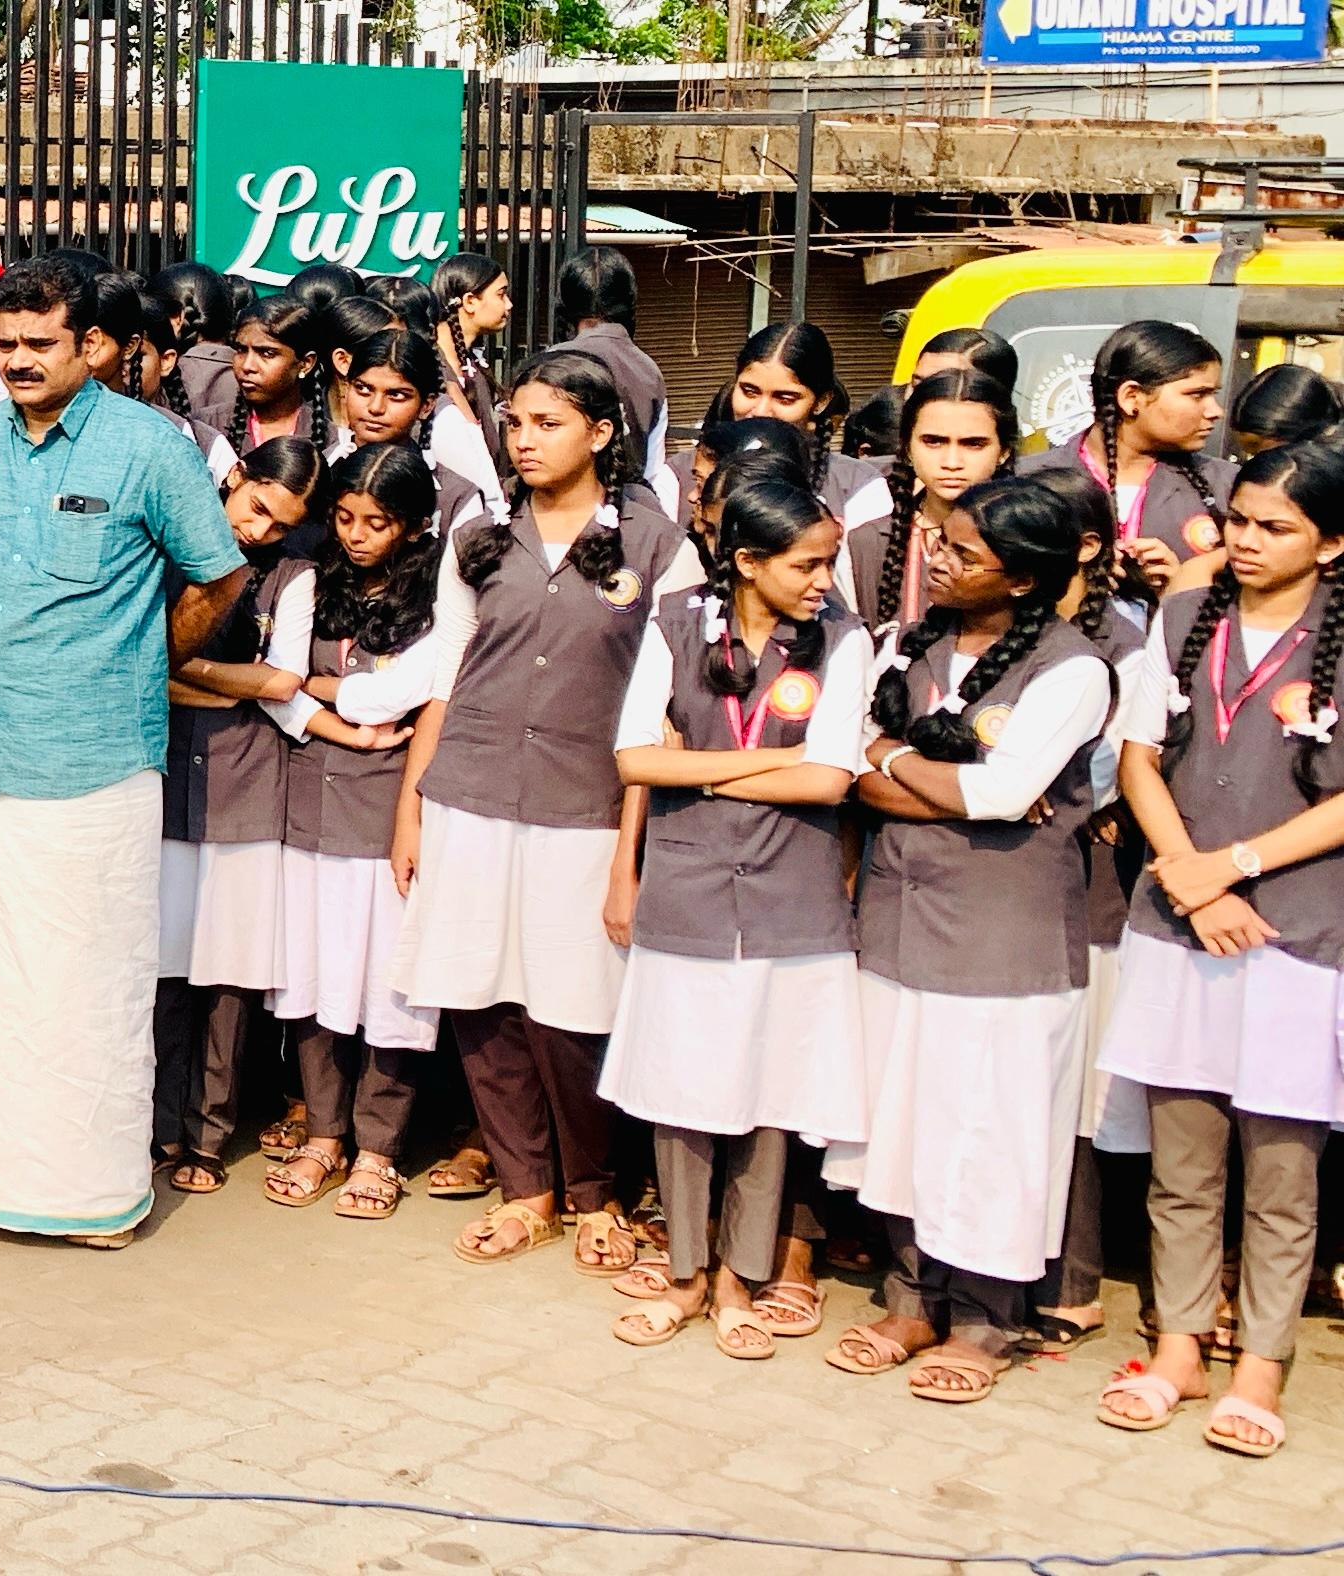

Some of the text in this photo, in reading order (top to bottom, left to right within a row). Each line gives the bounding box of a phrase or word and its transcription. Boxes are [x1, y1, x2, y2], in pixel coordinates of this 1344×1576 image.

[1148, 0, 1305, 28] HOSPITAL
[1103, 30, 1234, 43] HIJAMA CENTRE
[224, 165, 449, 287] LuLu
